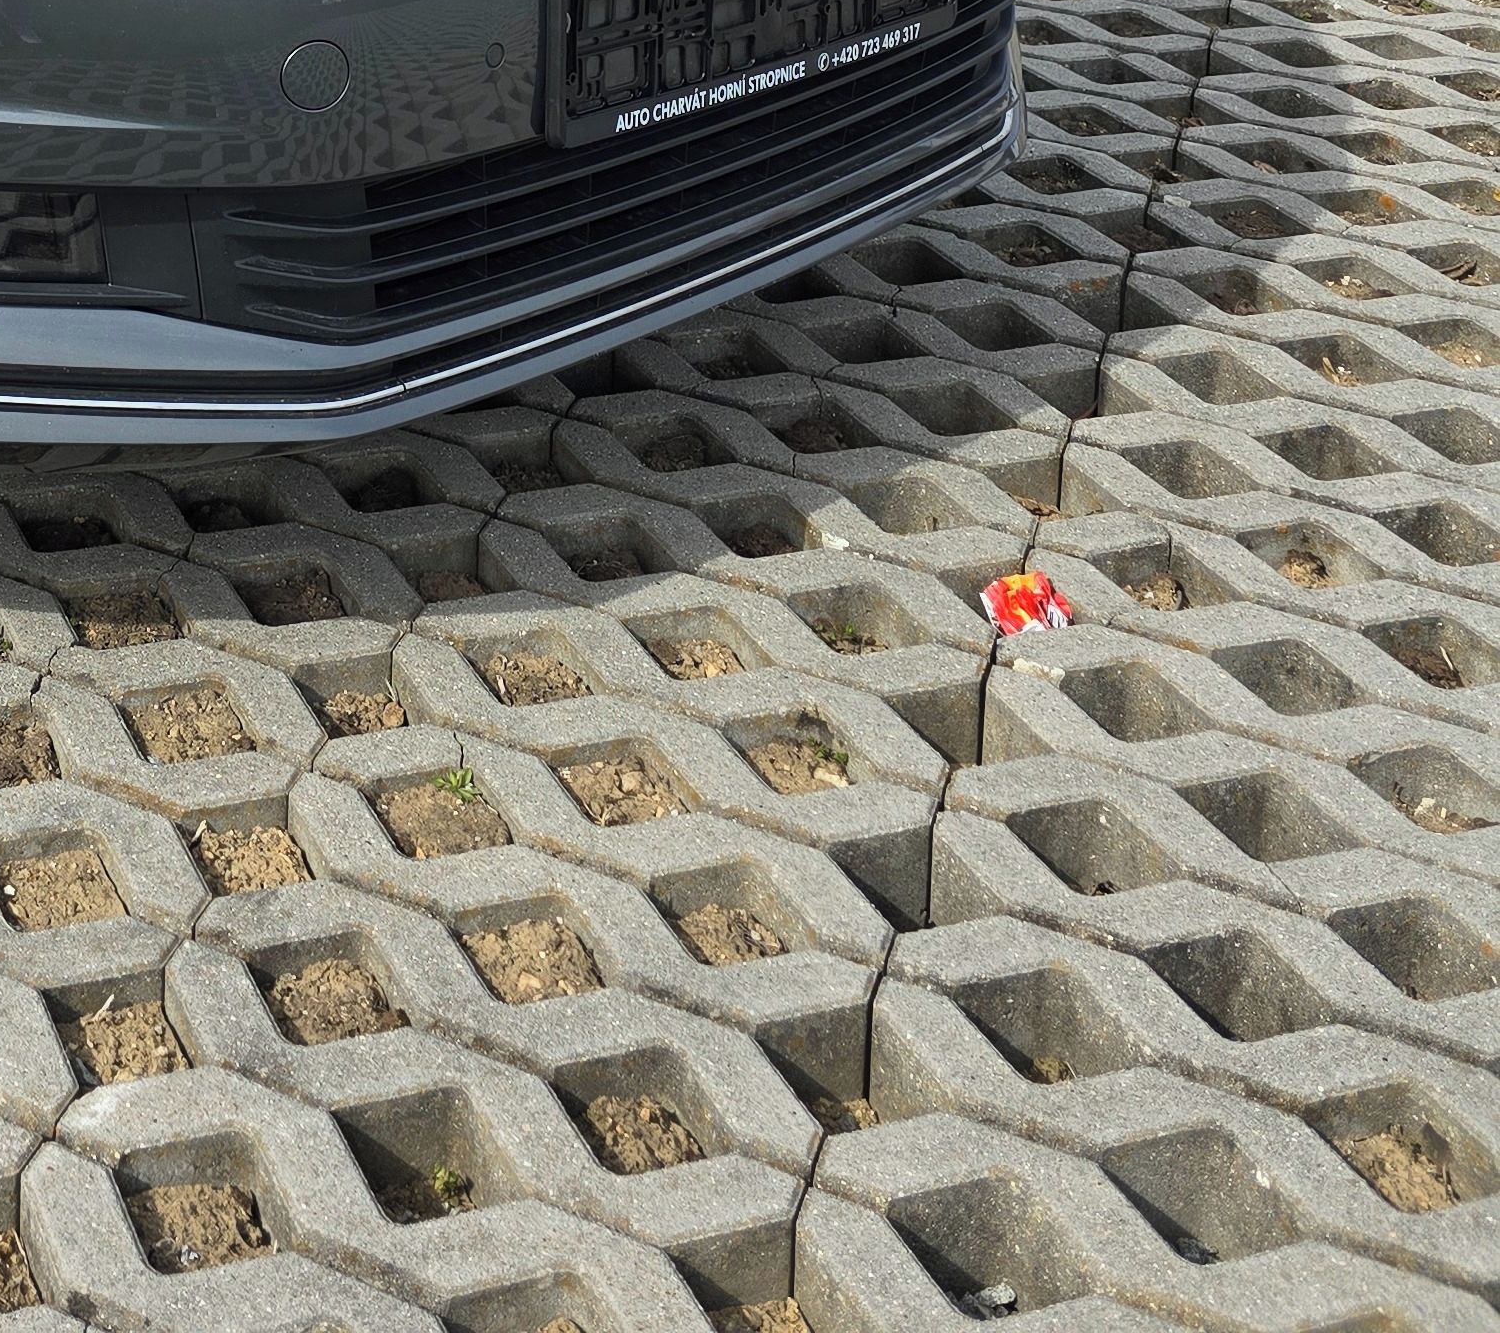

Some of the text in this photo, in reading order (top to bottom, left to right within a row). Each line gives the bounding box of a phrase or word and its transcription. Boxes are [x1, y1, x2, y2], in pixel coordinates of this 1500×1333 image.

[616, 23, 921, 133] AUTO CHARVÁT HORNÍ STROPNICE +420 723 469 317
